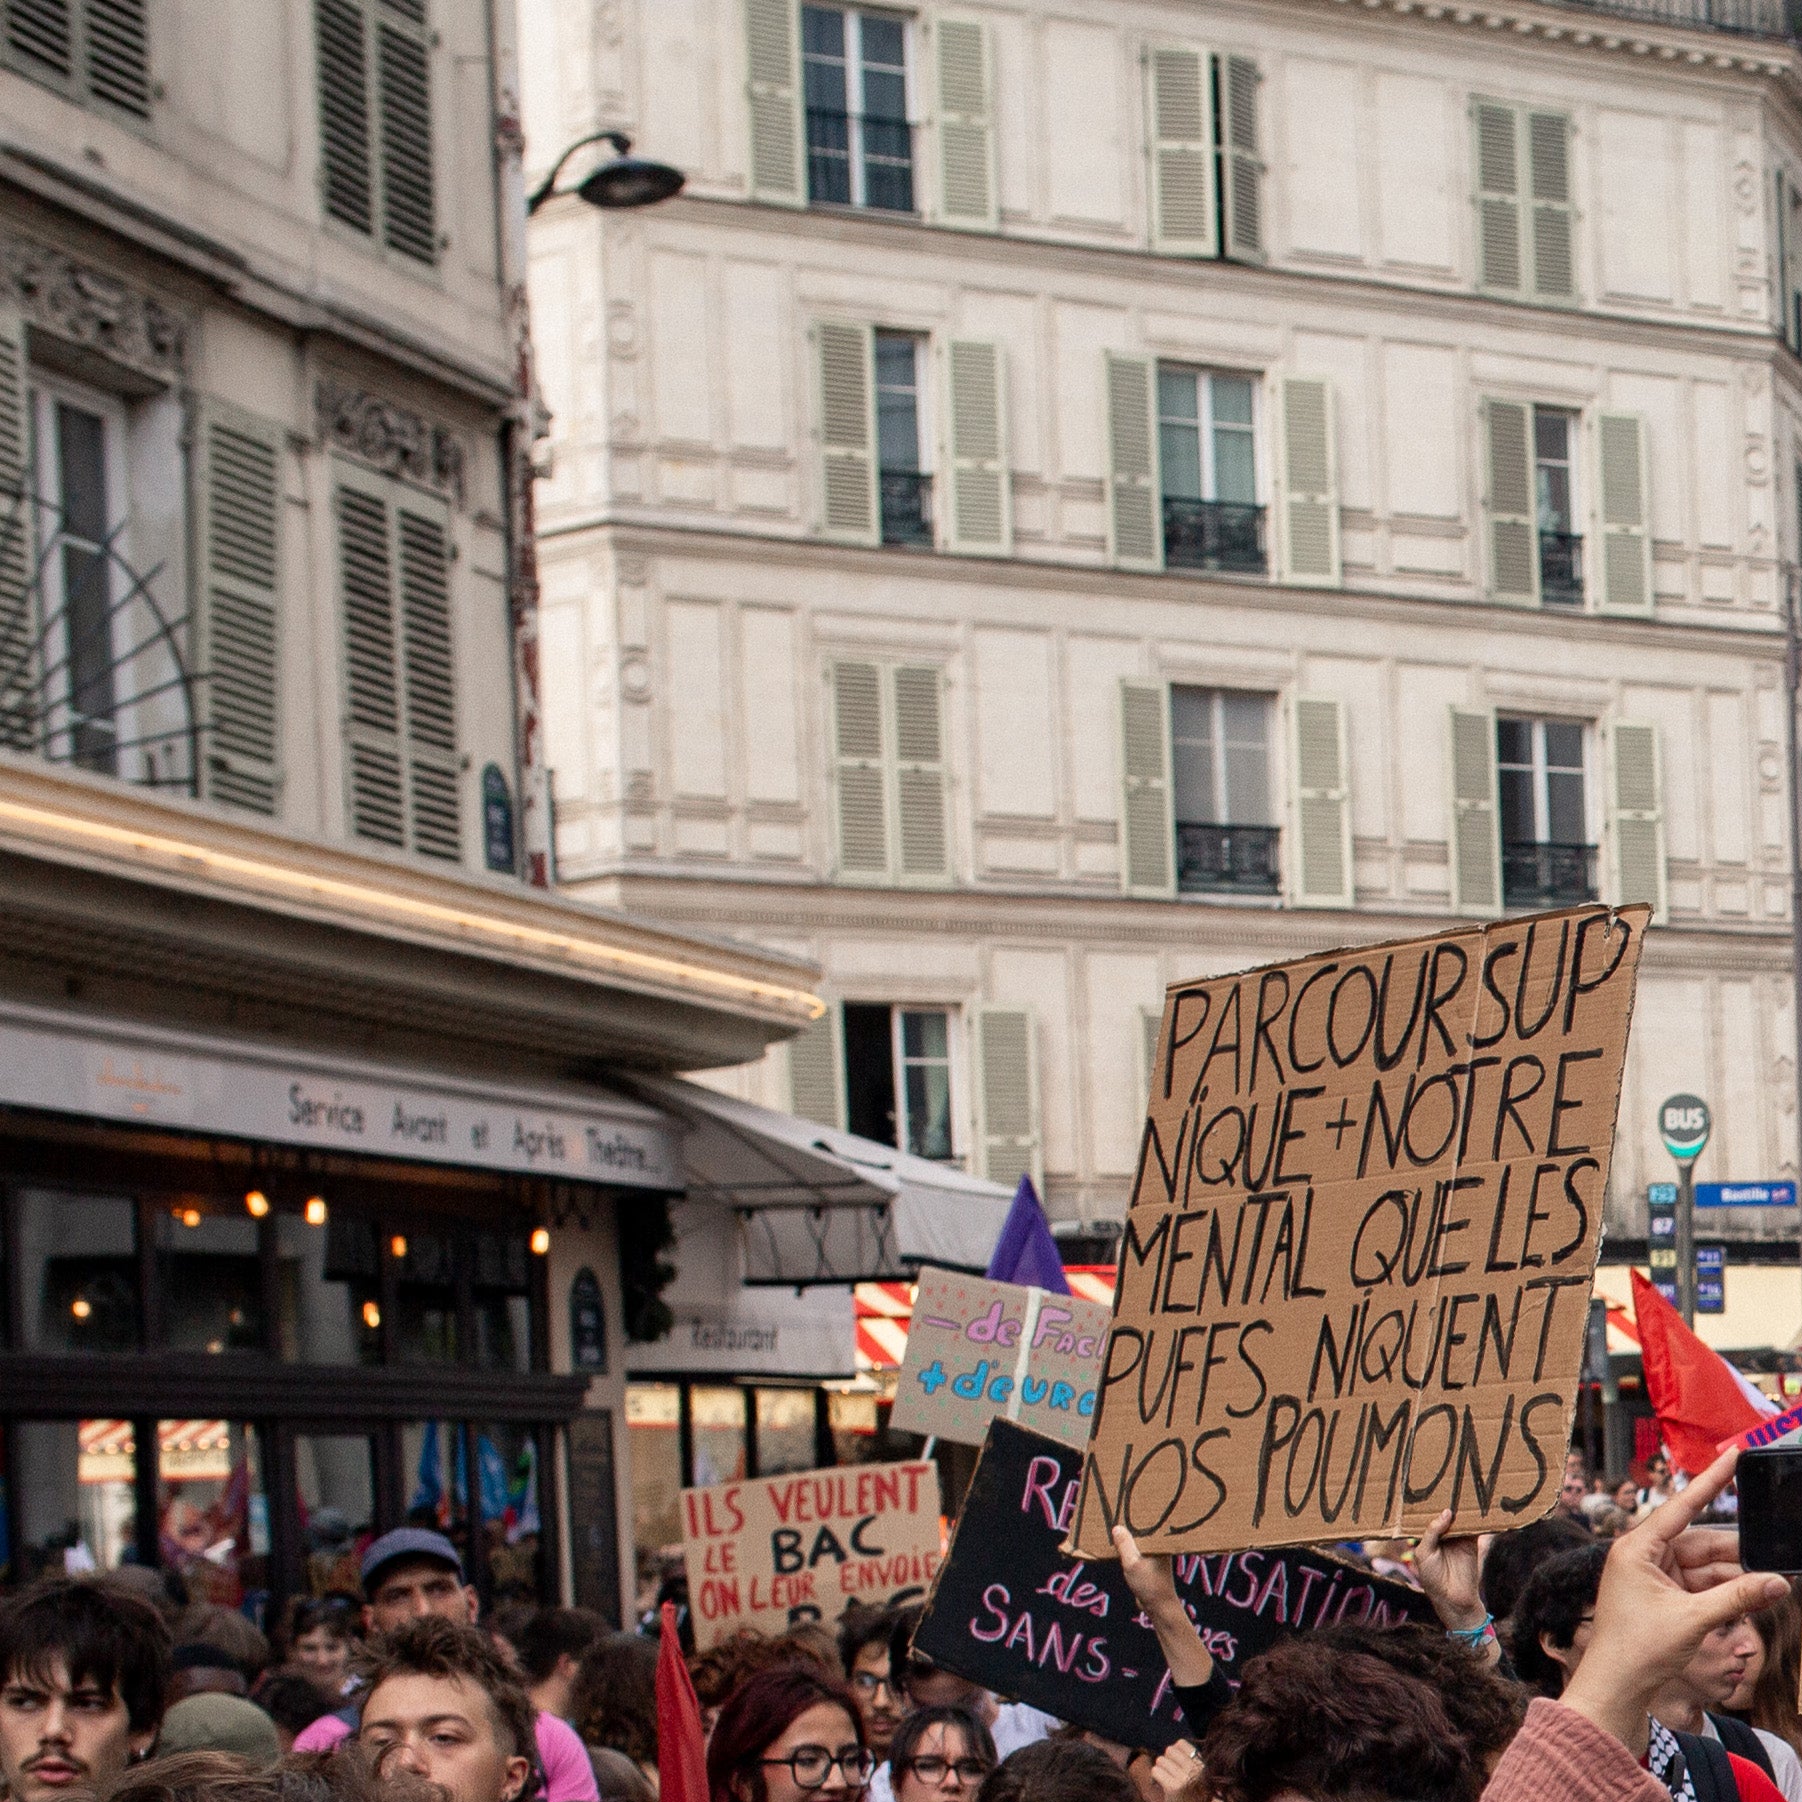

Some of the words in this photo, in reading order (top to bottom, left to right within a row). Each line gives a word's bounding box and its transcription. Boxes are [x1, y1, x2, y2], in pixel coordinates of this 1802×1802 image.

[1164, 914, 1632, 1099] PARCOURSUP
[288, 1083, 364, 1135] Service
[392, 1101, 448, 1144] Avant
[471, 1123, 489, 1150] et
[1664, 1107, 1704, 1130] BUS
[1112, 1187, 1326, 1317] MENTAL
[690, 1322, 779, 1353] Restaurant
[1089, 1318, 1274, 1441] PUFFS
[687, 1487, 745, 1539] ILS
[767, 1464, 930, 1523] VEULENT
[1073, 1427, 1231, 1548] NOS
[1252, 1392, 1564, 1528] POUMONS
[705, 1542, 737, 1574] LE
[772, 1515, 885, 1574] BAC
[699, 1577, 740, 1620] ON
[749, 1573, 817, 1611] LEUR
[1036, 1561, 1110, 1617] des
